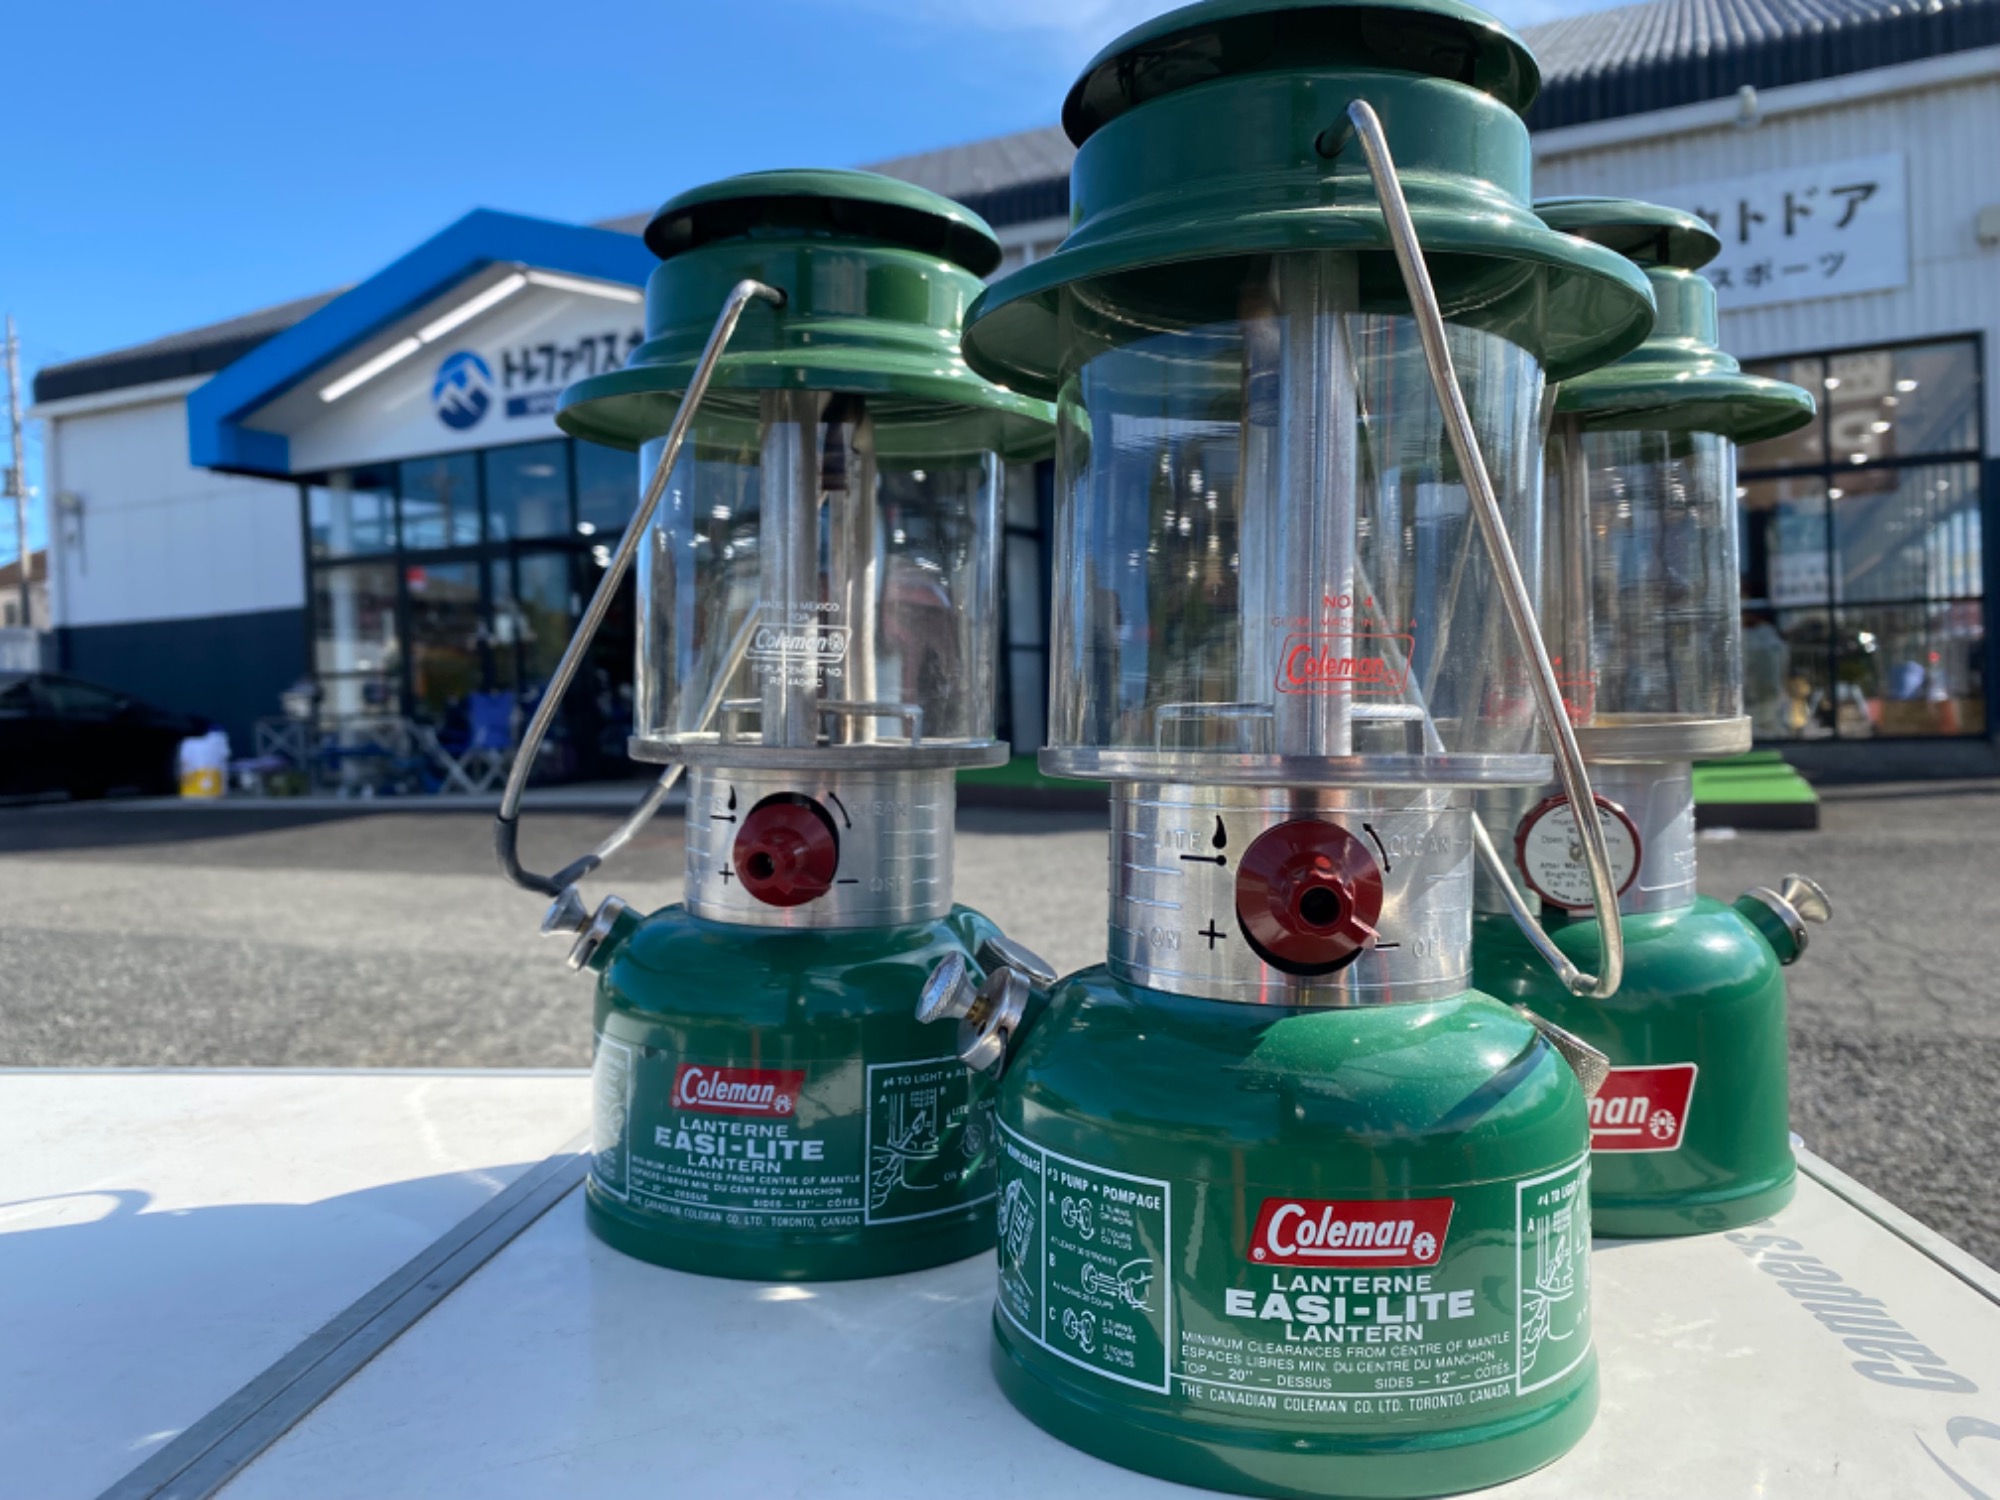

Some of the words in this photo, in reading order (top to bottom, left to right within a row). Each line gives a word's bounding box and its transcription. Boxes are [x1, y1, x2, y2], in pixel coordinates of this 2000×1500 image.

[755, 628, 827, 651] Coleman
[1286, 643, 1384, 686] Coleman
[680, 1067, 775, 1105] Coleman
[897, 1075, 911, 1086] TO
[914, 1071, 943, 1084] LIGHT
[680, 1116, 789, 1138] LANTERNE
[655, 1125, 825, 1161] EASI-LITE
[687, 1153, 782, 1174] LANTERN
[713, 1183, 727, 1192] DU
[730, 1184, 768, 1195] CENTRE
[771, 1187, 786, 1196] DU
[788, 1187, 843, 1196] MANCHON
[726, 1174, 755, 1184] FROM
[760, 1175, 799, 1186] CENTRE
[802, 1175, 816, 1186] OF
[820, 1174, 860, 1185] MANTLE
[1060, 1171, 1089, 1192] PUMP
[1102, 1184, 1162, 1211] POMPAGE
[753, 1199, 782, 1208] SIDES
[821, 1215, 860, 1227] CANADA
[1267, 1203, 1415, 1257] Coleman
[1527, 1216, 1534, 1233] A
[1272, 1273, 1432, 1294] LANTERNE
[1049, 1306, 1056, 1320] C
[1225, 1287, 1475, 1325] EASI-LITE
[1723, 1233, 1979, 1393] Campers
[1182, 1330, 1244, 1350] MINIMUM
[1247, 1340, 1342, 1358] CLEARANCES
[1346, 1346, 1386, 1358] FROM
[1390, 1343, 1442, 1357] CENTRE
[1446, 1339, 1462, 1352] OF
[1467, 1331, 1510, 1349] MANTLE
[1285, 1323, 1424, 1343] LANTERN
[1182, 1344, 1242, 1365] ESPACES
[1246, 1356, 1295, 1371] LIBRES
[1299, 1360, 1328, 1372] MIN.
[1333, 1361, 1355, 1373] DU
[1356, 1359, 1410, 1373] CENTRE
[1414, 1358, 1431, 1370] DU
[1435, 1350, 1495, 1368] MANCHON
[1181, 1361, 1207, 1374] TOP
[1277, 1374, 1332, 1389] DESSUS
[1374, 1377, 1414, 1390] SIDES
[1180, 1382, 1203, 1398] THE
[1209, 1388, 1276, 1409] CANADIAN
[1283, 1397, 1347, 1413] COLEMAN
[1354, 1400, 1374, 1414] CO.
[1378, 1399, 1404, 1413] LTD.
[1469, 1383, 1511, 1403] CANADA
